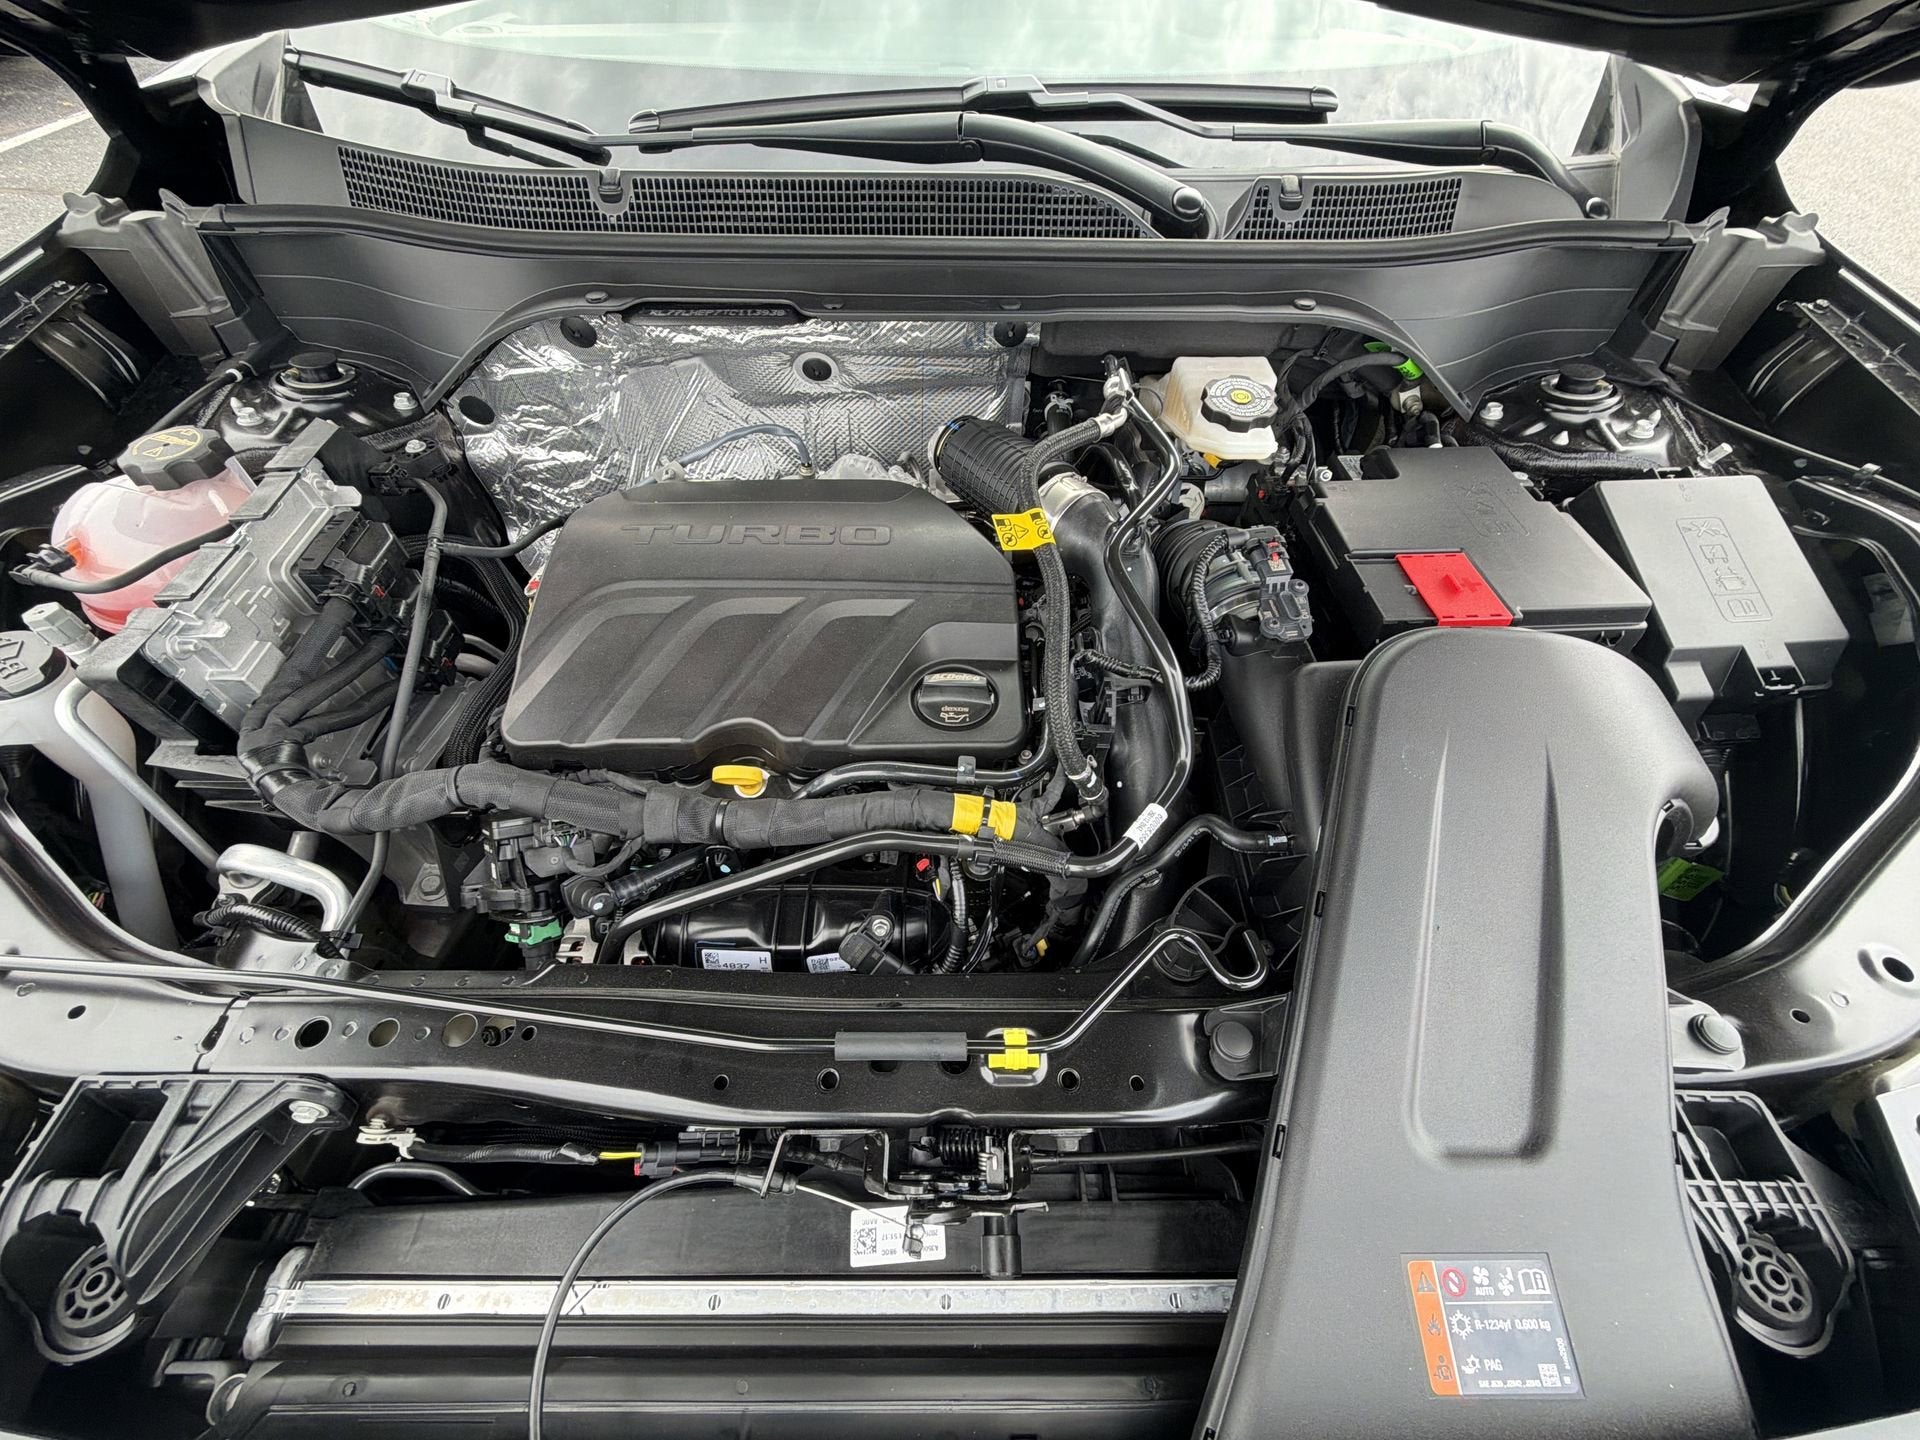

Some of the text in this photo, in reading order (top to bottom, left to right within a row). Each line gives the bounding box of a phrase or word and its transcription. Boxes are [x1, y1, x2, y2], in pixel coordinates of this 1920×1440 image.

[621, 524, 892, 545] TURBO
[931, 672, 980, 680] ACDelco
[1475, 1287, 1495, 1296] AUTO
[1474, 1319, 1551, 1332] R-1234yf 0.600 kg
[1483, 1358, 1503, 1371] PAG
